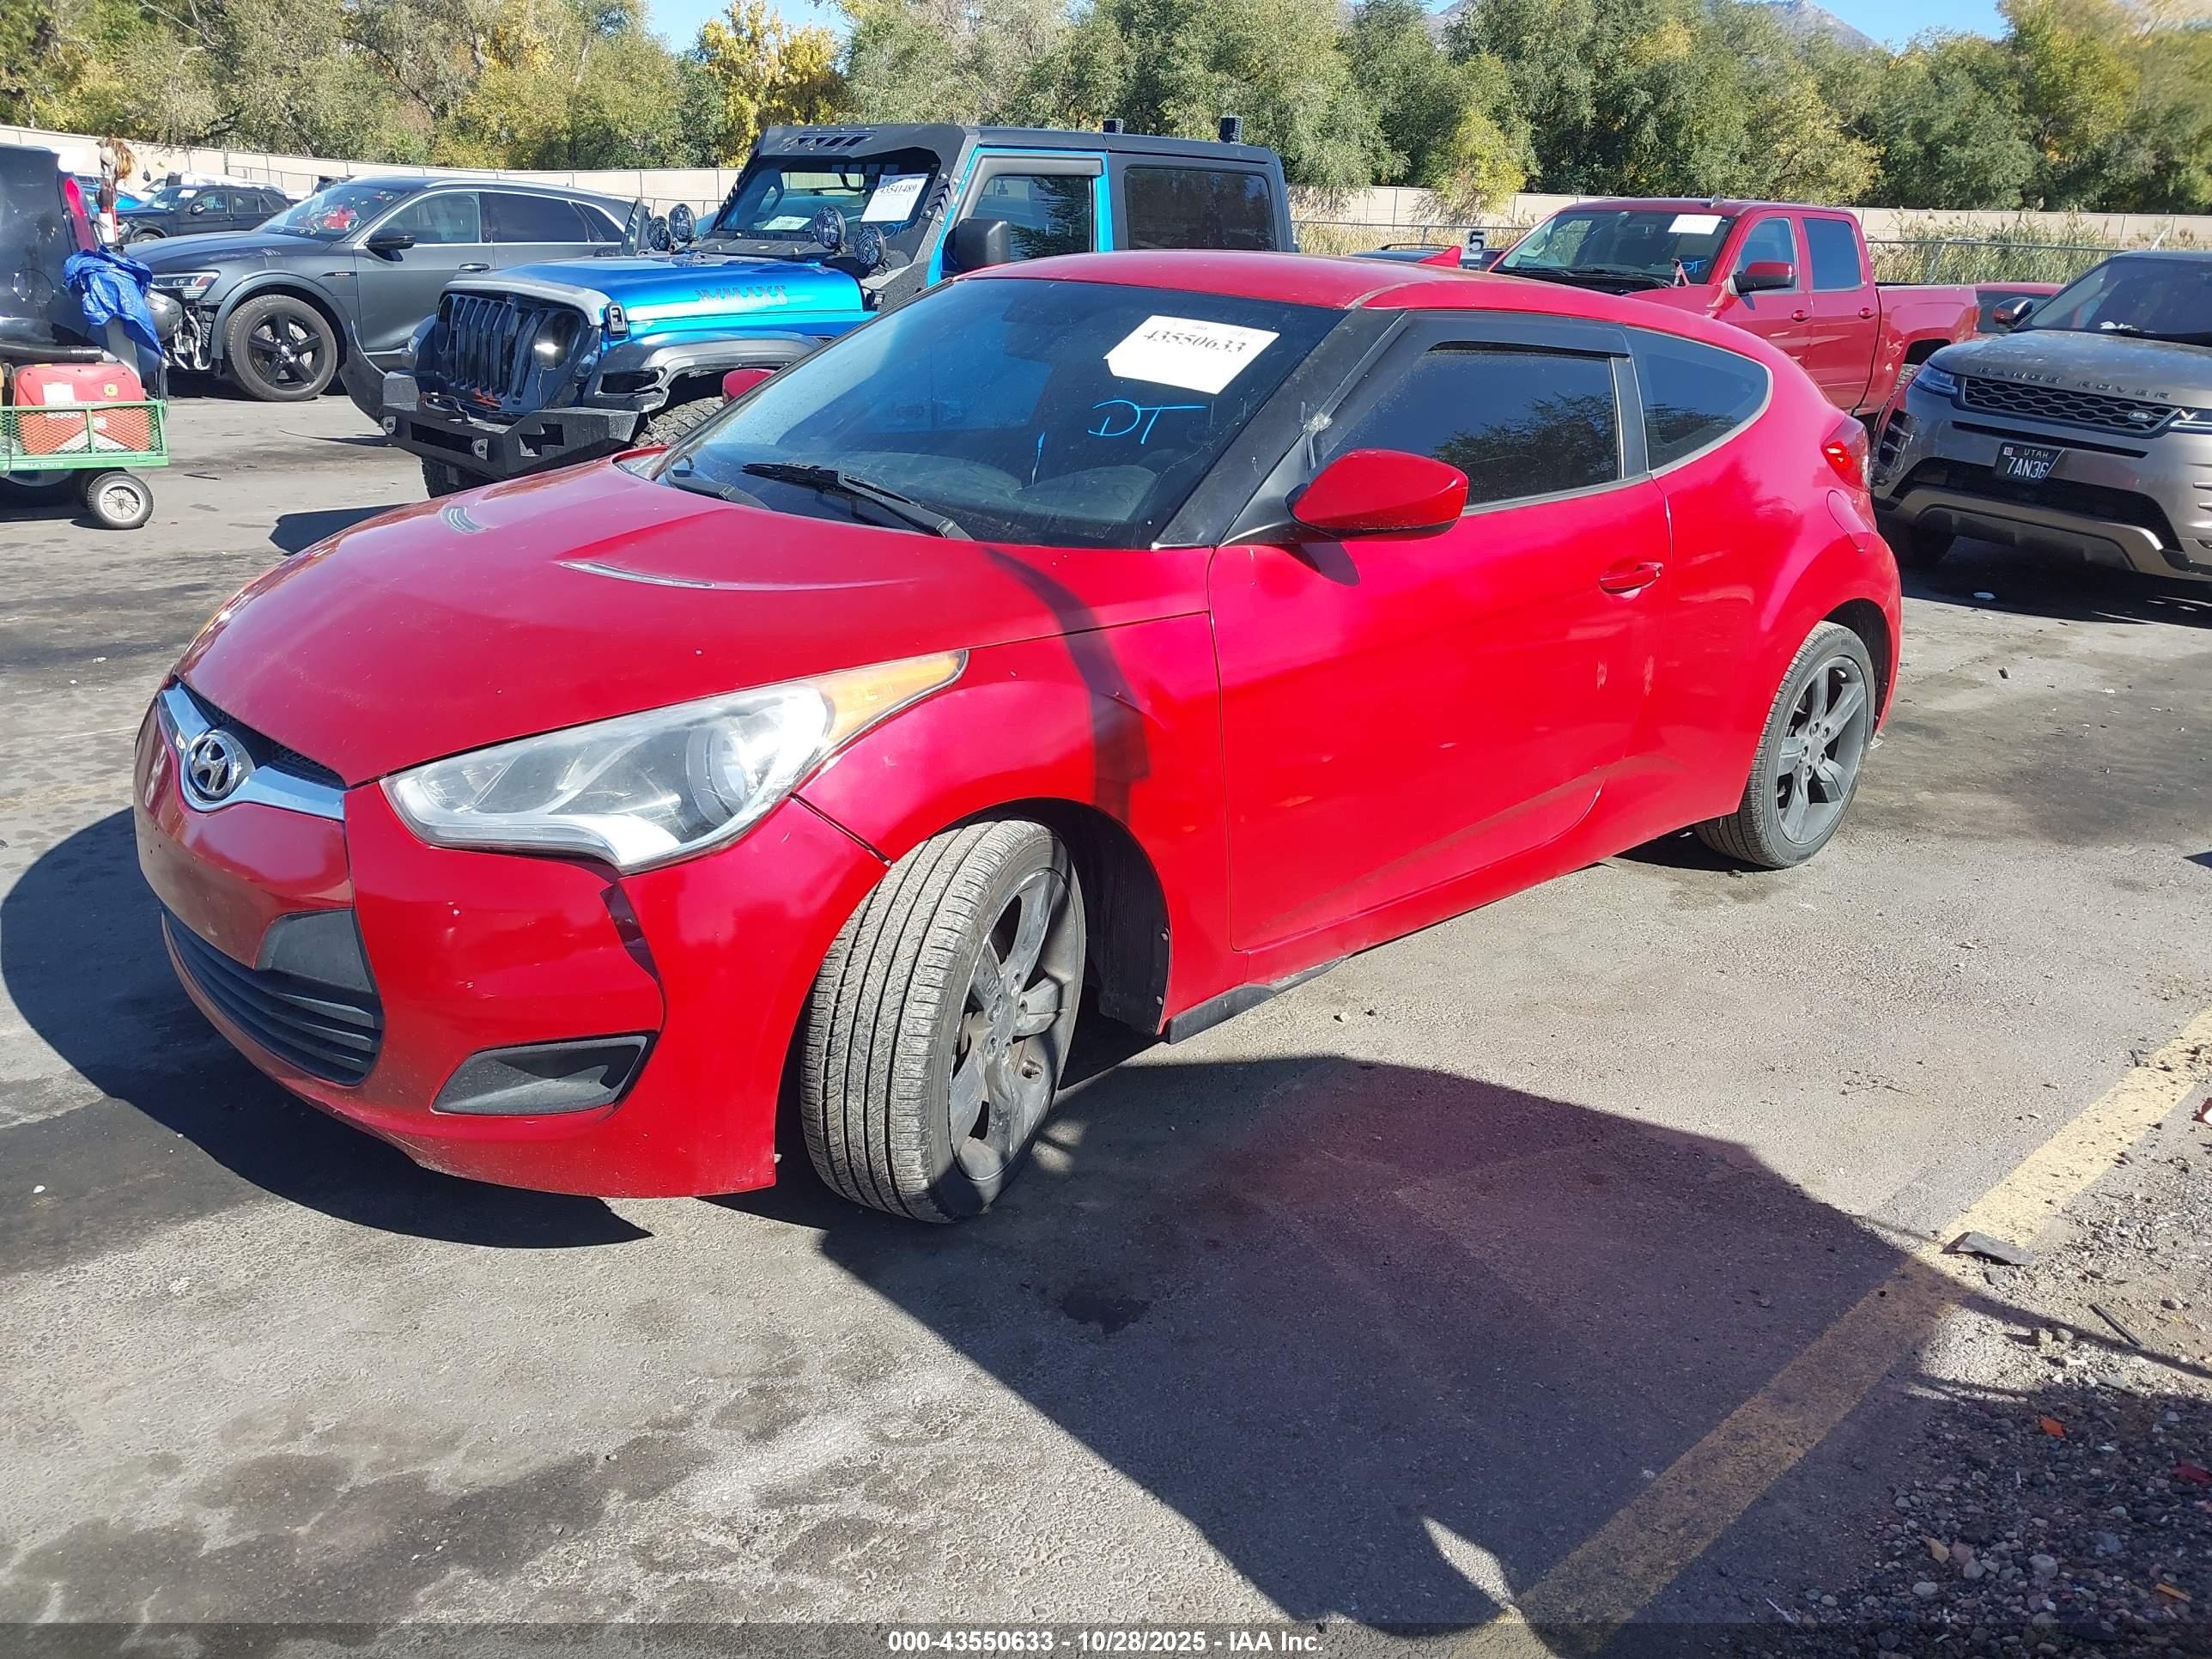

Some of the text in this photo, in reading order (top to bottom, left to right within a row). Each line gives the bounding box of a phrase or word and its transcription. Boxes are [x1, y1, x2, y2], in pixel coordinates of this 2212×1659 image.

[1469, 231, 1485, 252] 5
[1144, 330, 1247, 353] 43550633
[1978, 367, 2172, 401] RANGE ROVER
[1087, 399, 1208, 445] DT
[2024, 447, 2050, 459] UTAH
[2006, 456, 2050, 479] 7AN36
